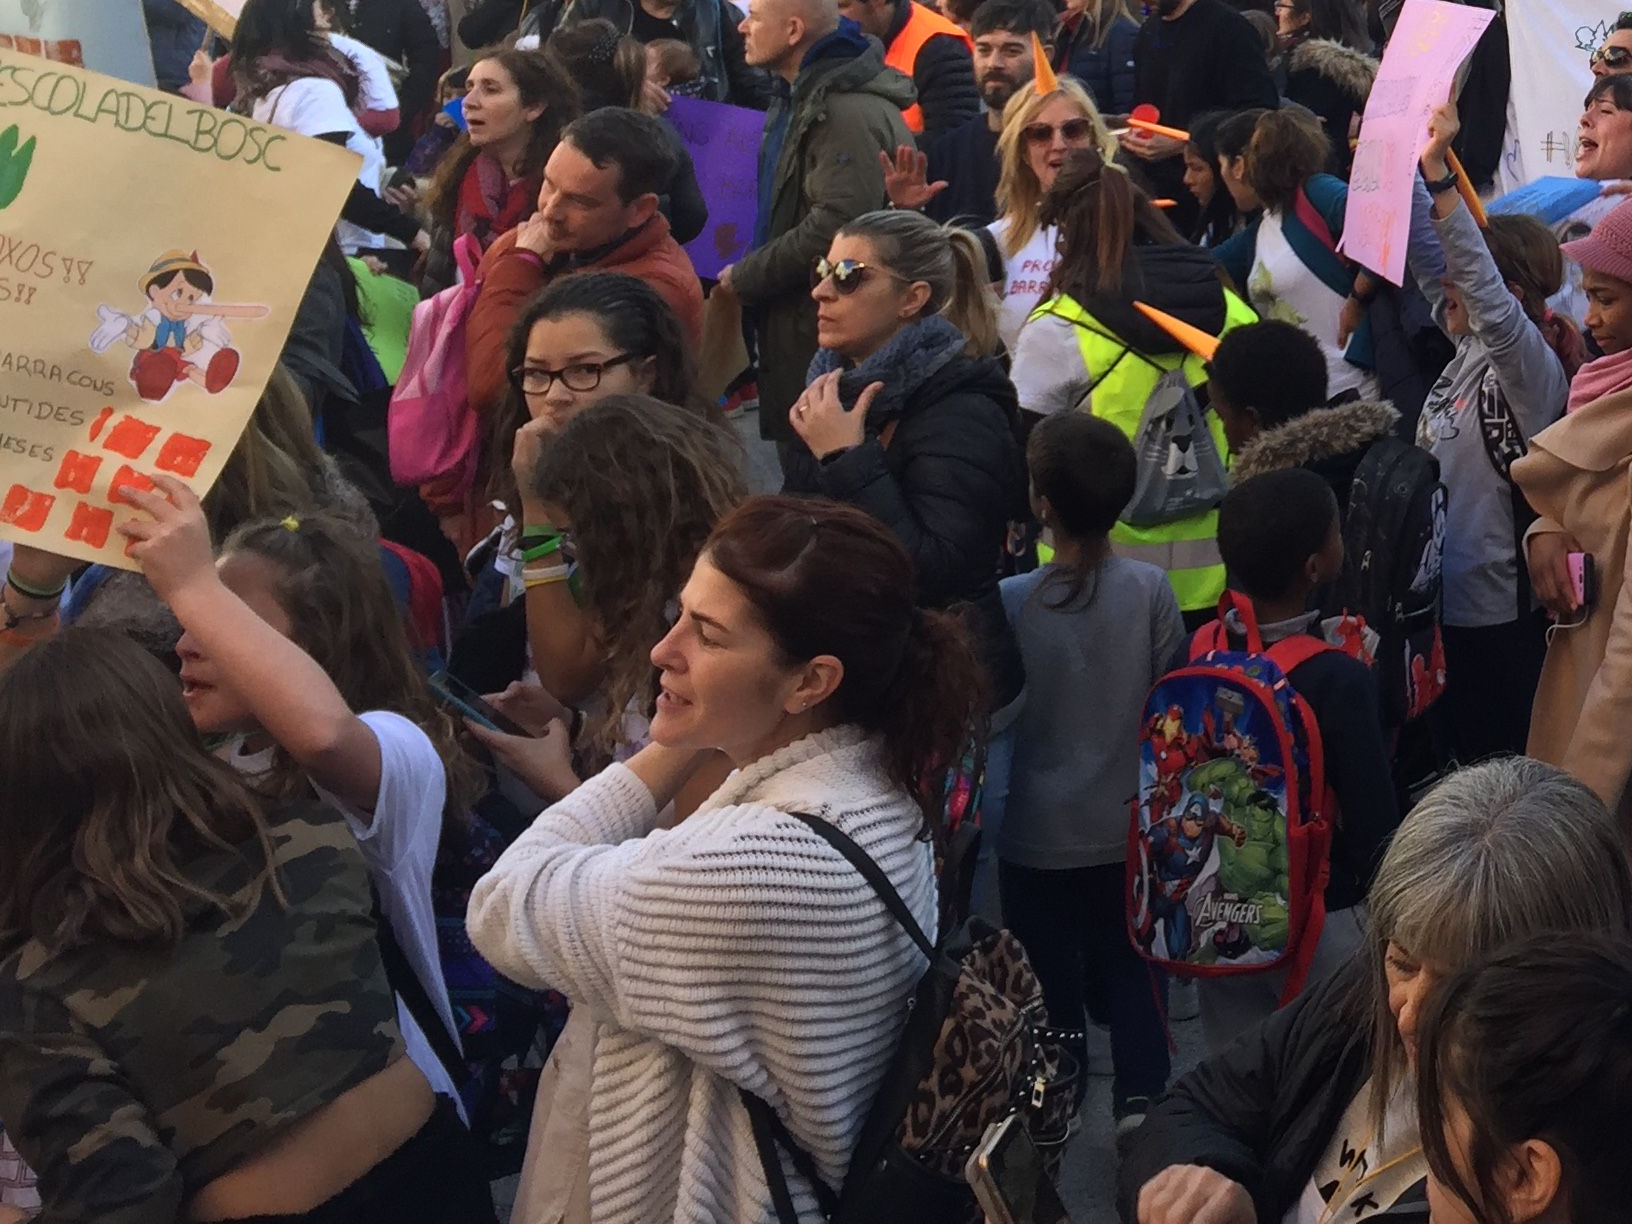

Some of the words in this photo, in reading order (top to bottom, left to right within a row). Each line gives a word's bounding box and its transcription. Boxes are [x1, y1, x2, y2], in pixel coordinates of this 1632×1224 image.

[1021, 259, 1056, 273] PRO
[1010, 279, 1050, 295] BARR
[0, 352, 115, 397] ARRACONS
[1195, 892, 1263, 926] AVENGERS
